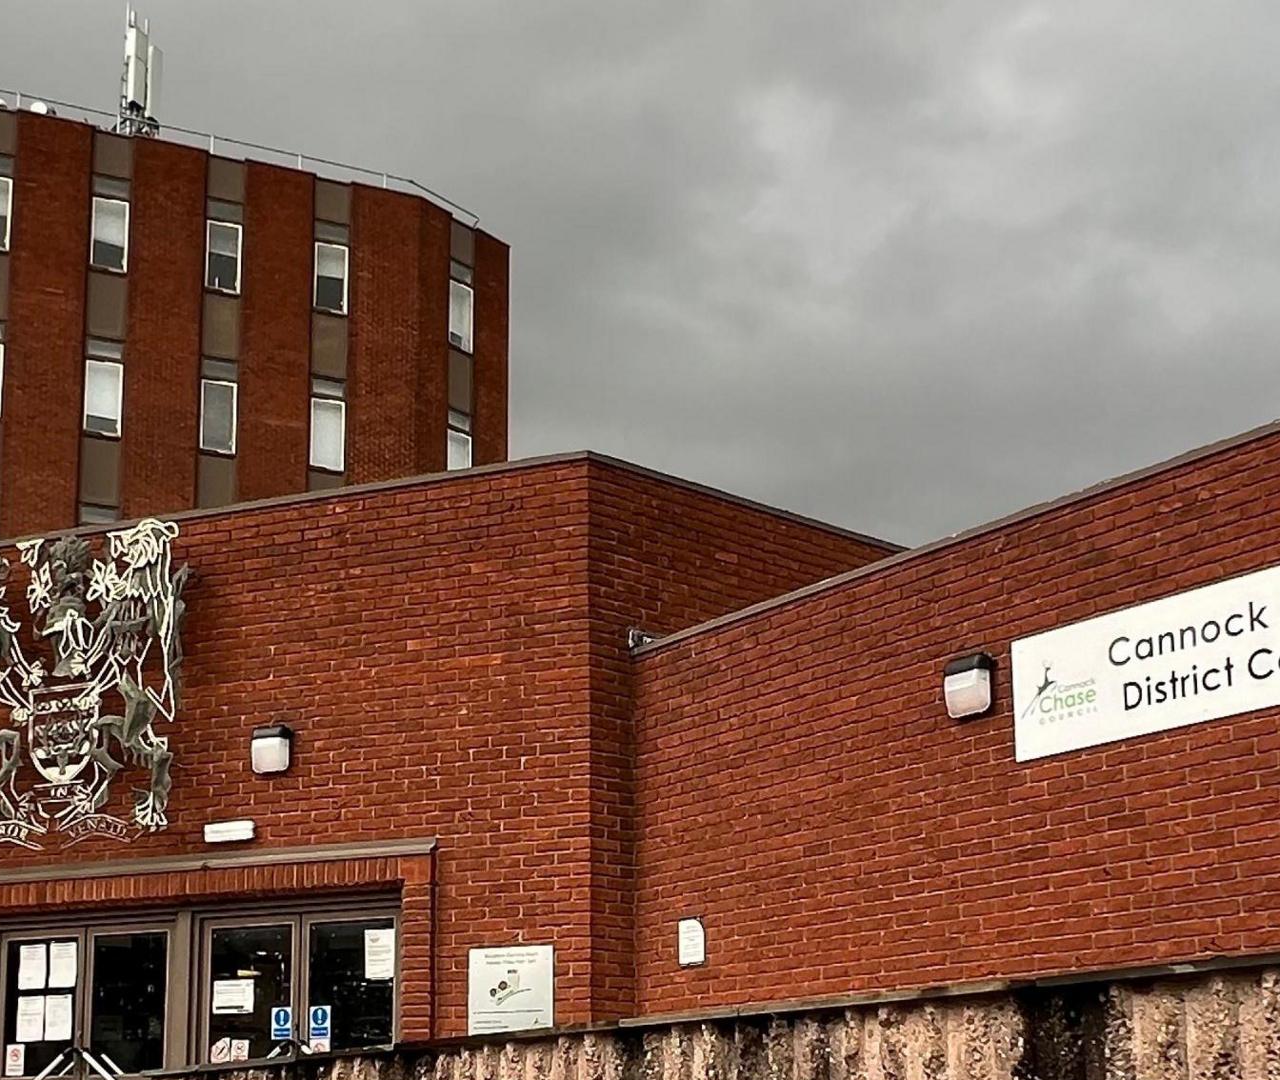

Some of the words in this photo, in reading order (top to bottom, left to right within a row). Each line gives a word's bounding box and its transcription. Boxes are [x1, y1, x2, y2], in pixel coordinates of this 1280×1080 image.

[1108, 602, 1269, 666] Cannock
[1039, 689, 1096, 713] Chase
[1123, 657, 1234, 711] District
[1039, 705, 1098, 725] COUNCIL
